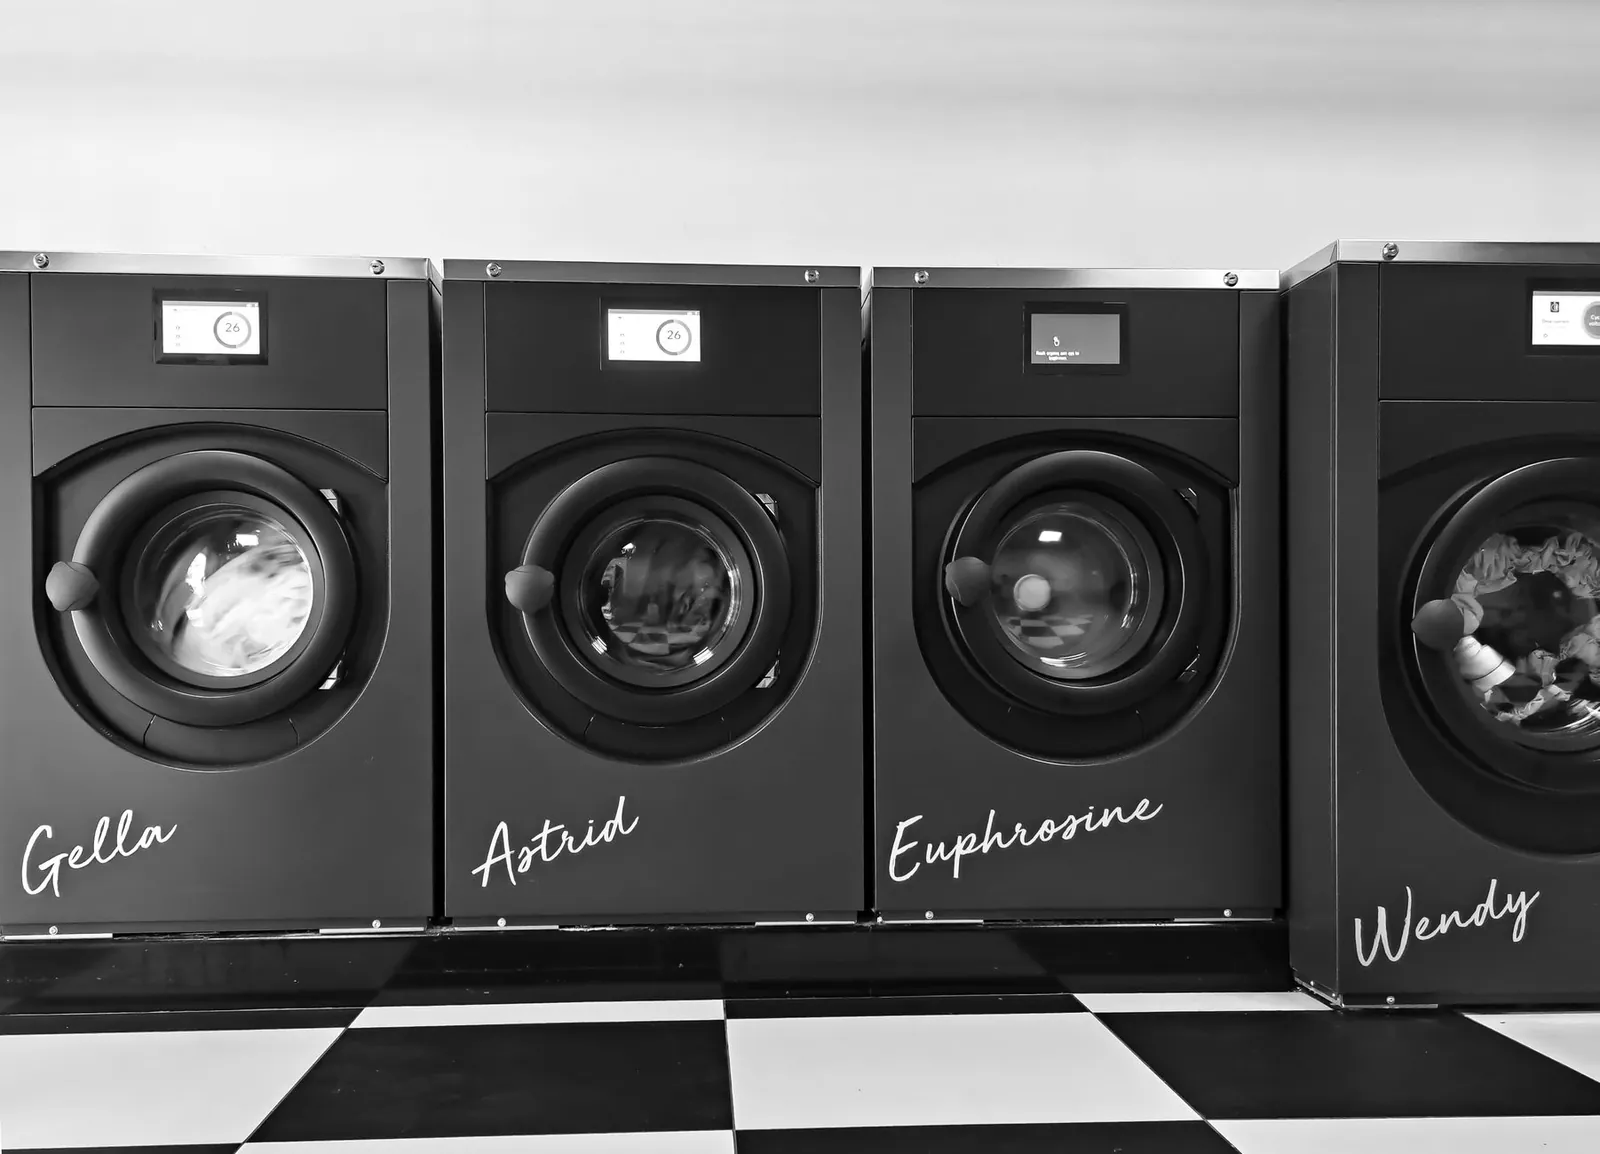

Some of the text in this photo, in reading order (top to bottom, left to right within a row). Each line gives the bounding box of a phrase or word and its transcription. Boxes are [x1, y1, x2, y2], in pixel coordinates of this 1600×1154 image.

[225, 322, 241, 333] 26
[667, 329, 682, 340] 26
[21, 808, 178, 898] Gella
[471, 795, 640, 888] Astrid
[888, 798, 1164, 882] Euphrosine
[1354, 878, 1541, 967] Wendy
